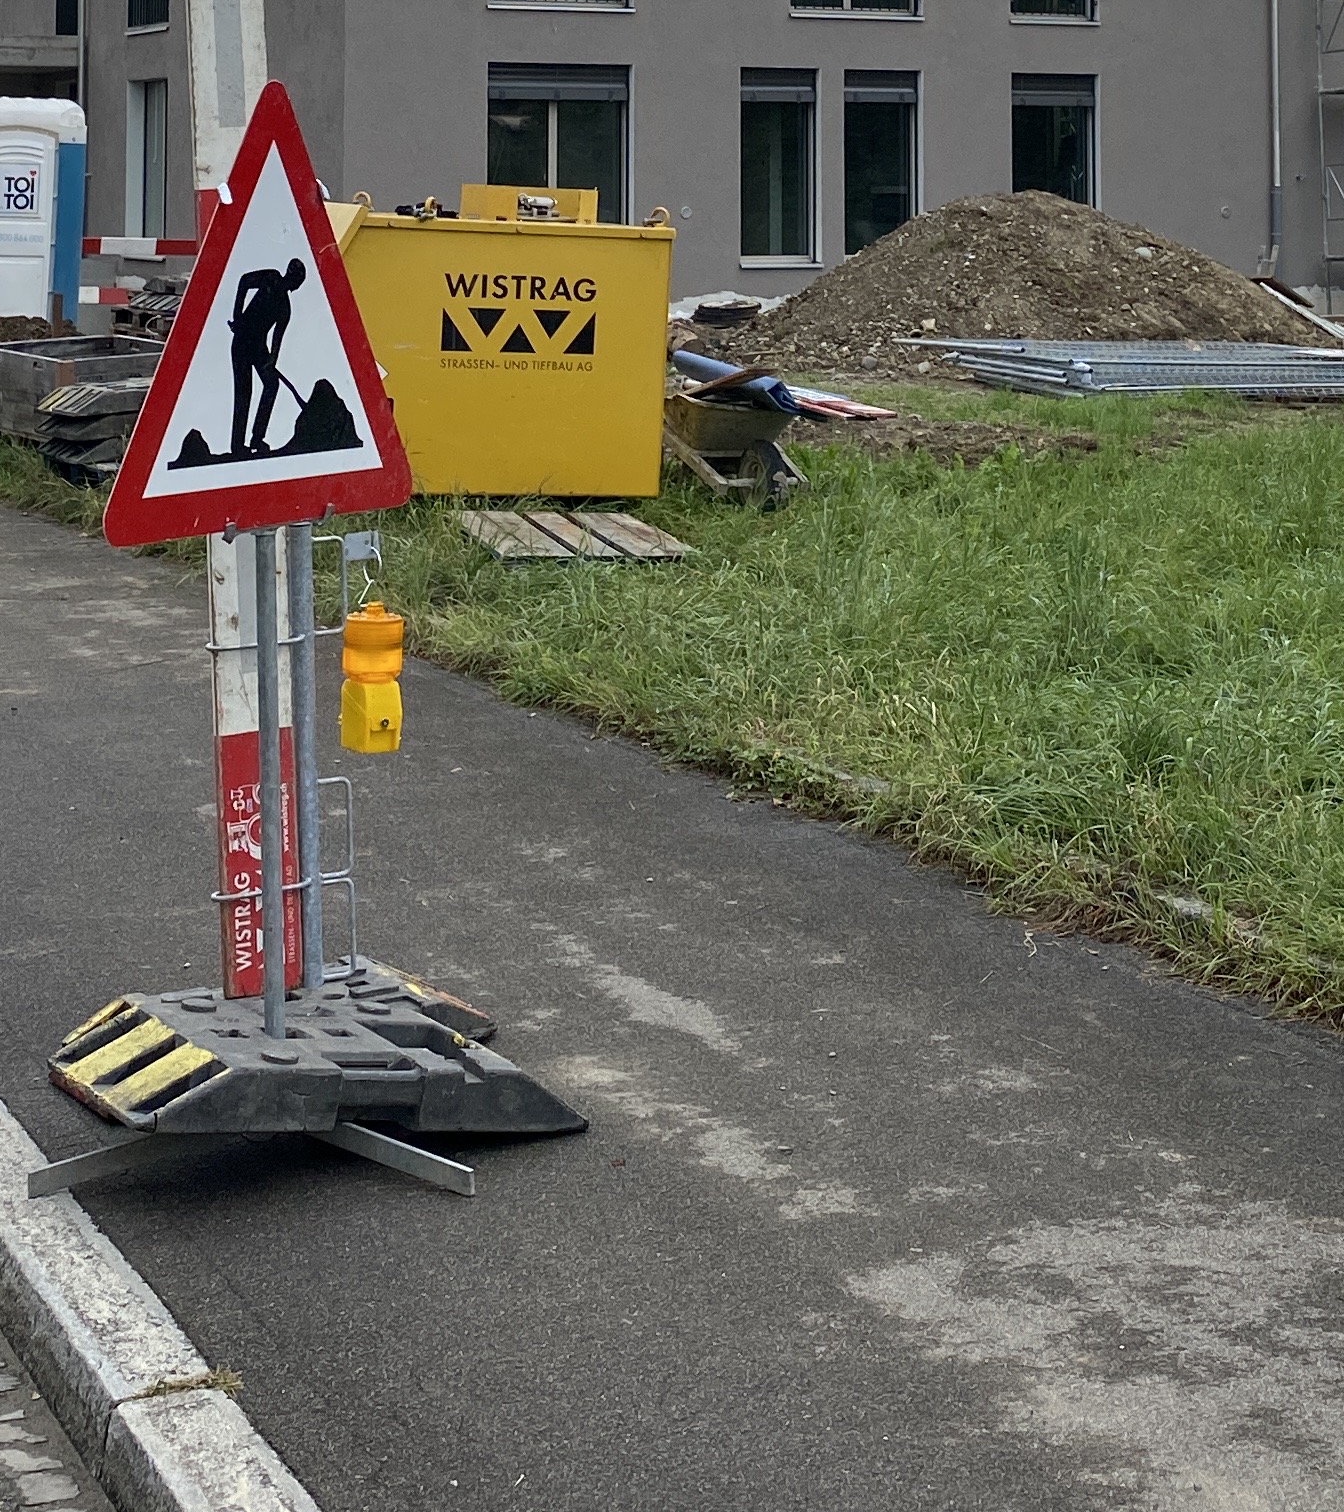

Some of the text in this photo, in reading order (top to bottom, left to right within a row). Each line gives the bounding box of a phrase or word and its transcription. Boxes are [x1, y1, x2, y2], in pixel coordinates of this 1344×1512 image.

[4, 171, 37, 194] TOI
[3, 194, 35, 210] TOI
[444, 272, 597, 302] WISTRAG
[439, 357, 594, 373] STRASSEN- UND TIEFBAU AG
[234, 871, 253, 972] WISTRAG
